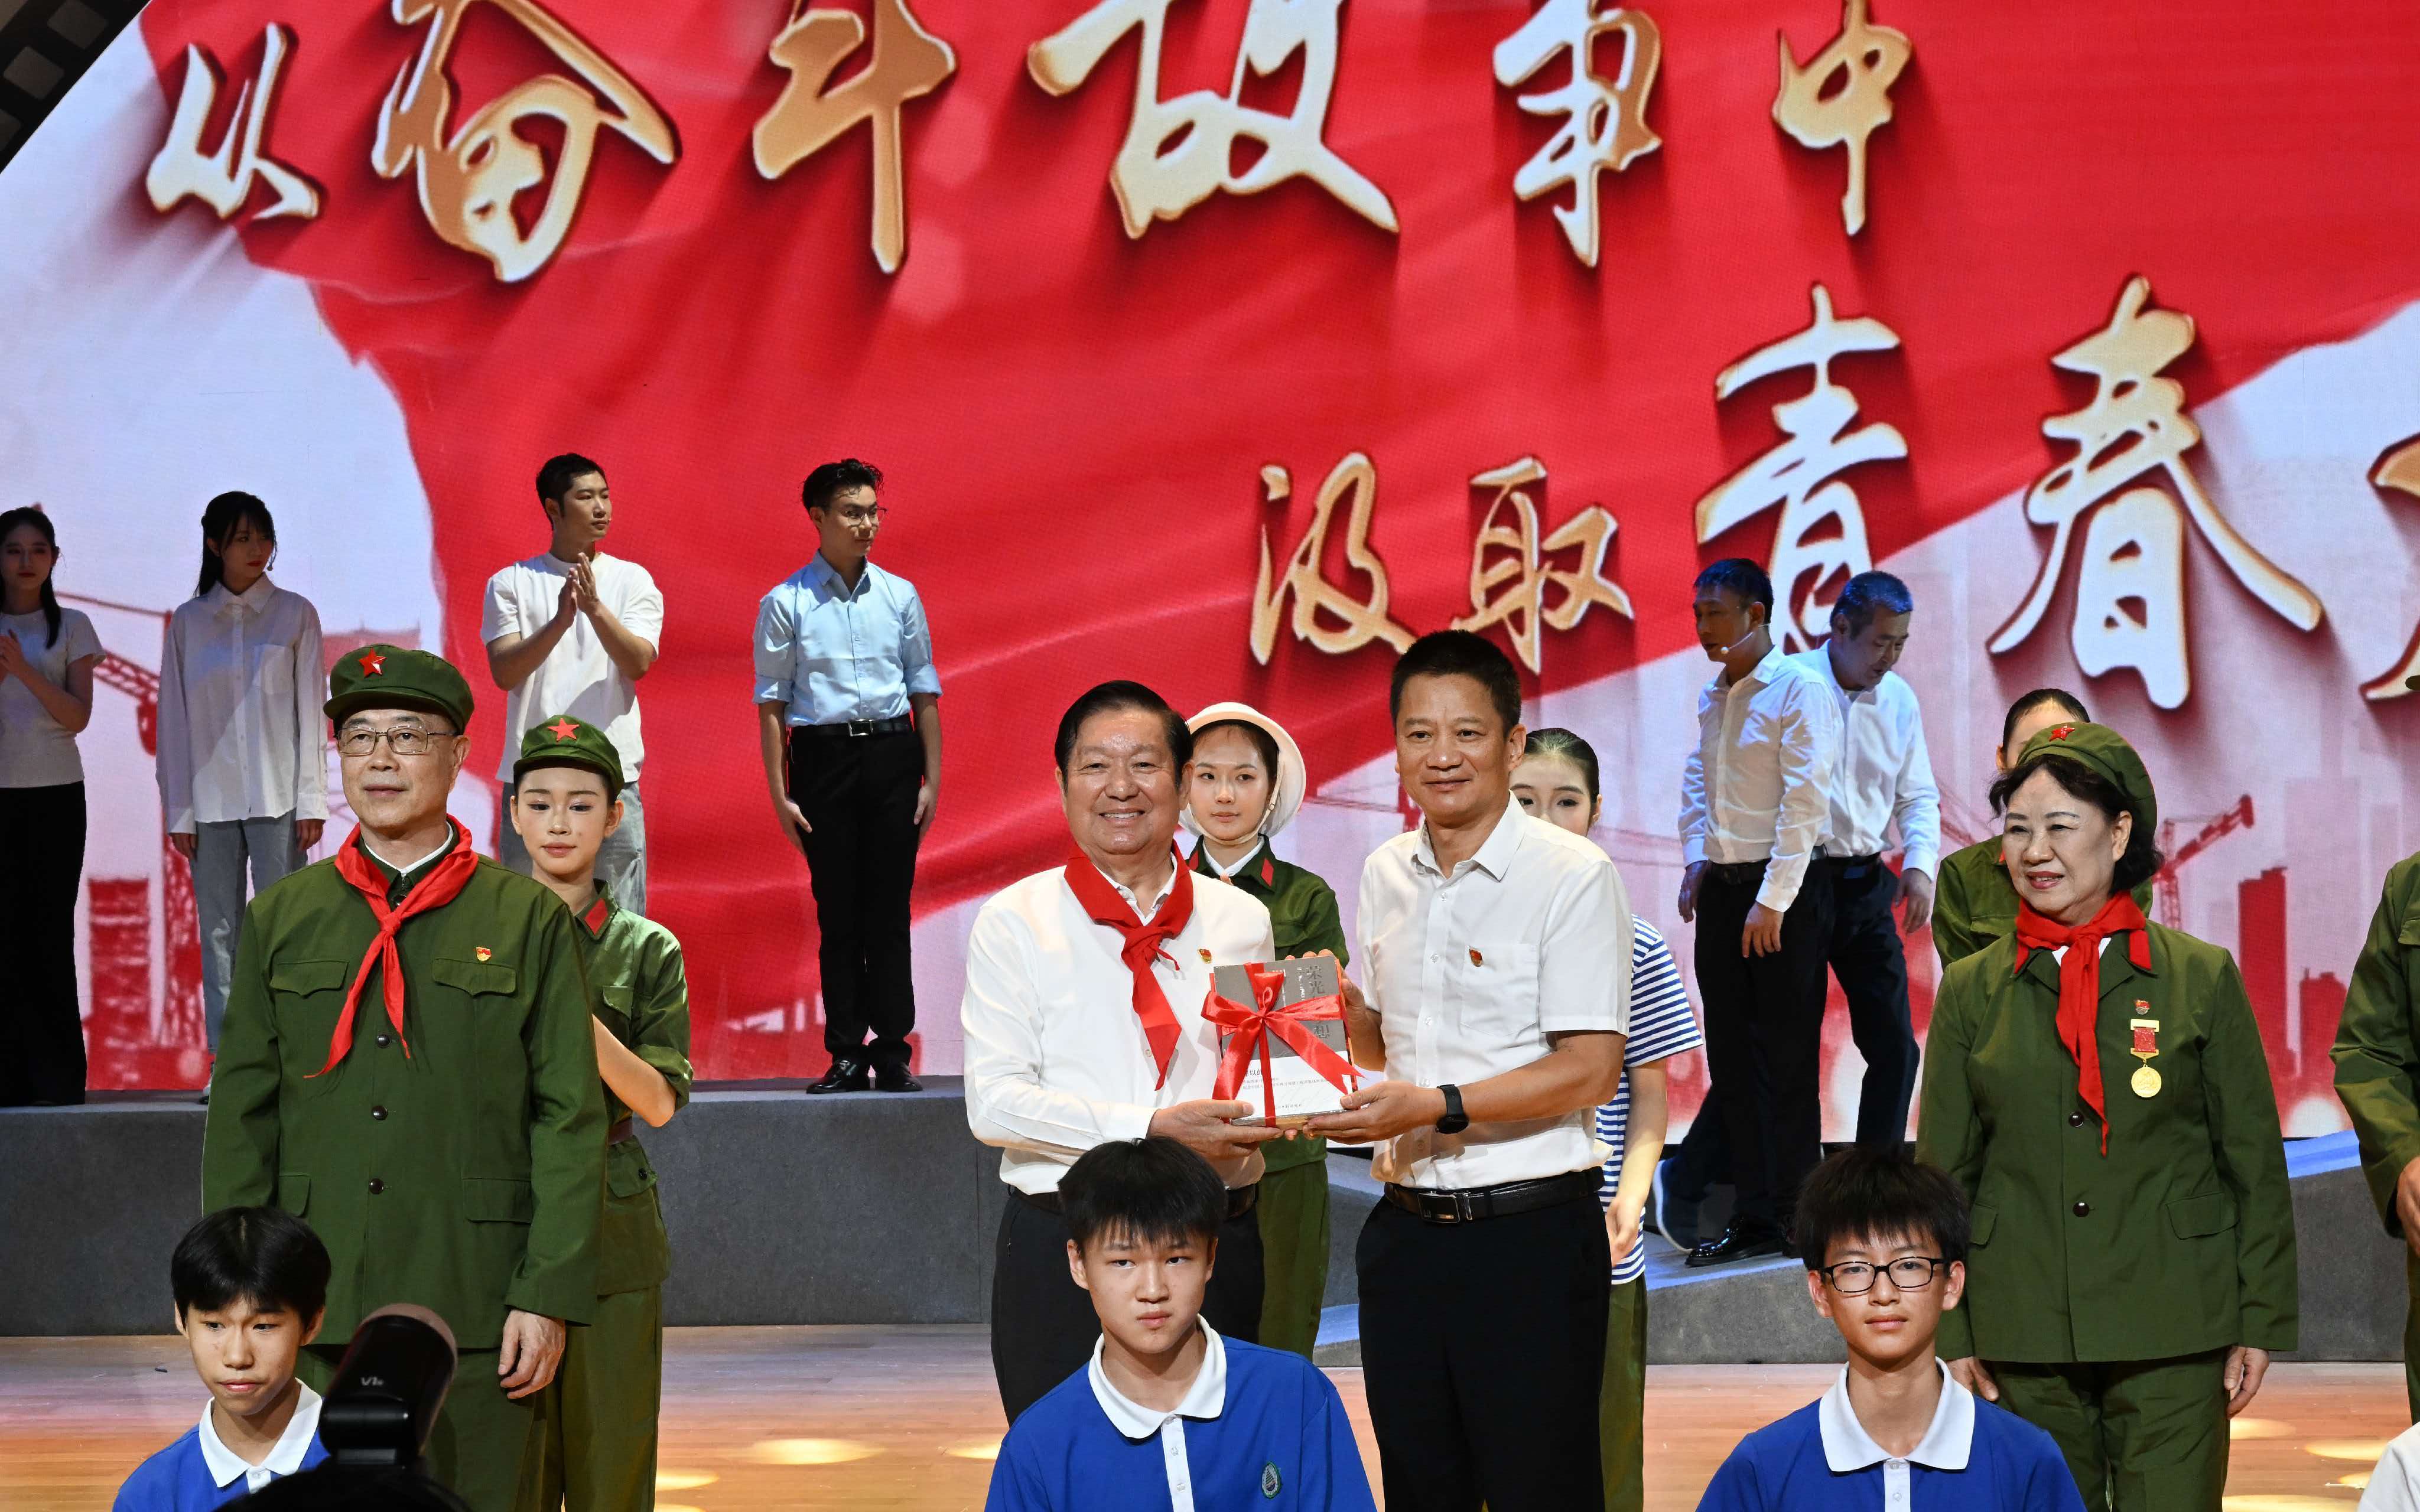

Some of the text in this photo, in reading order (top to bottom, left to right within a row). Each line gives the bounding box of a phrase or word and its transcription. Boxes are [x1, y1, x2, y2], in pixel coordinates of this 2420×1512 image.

[146, 0, 1912, 283] 从奋斗故事中
[1247, 272, 2420, 708] 汲取青春
